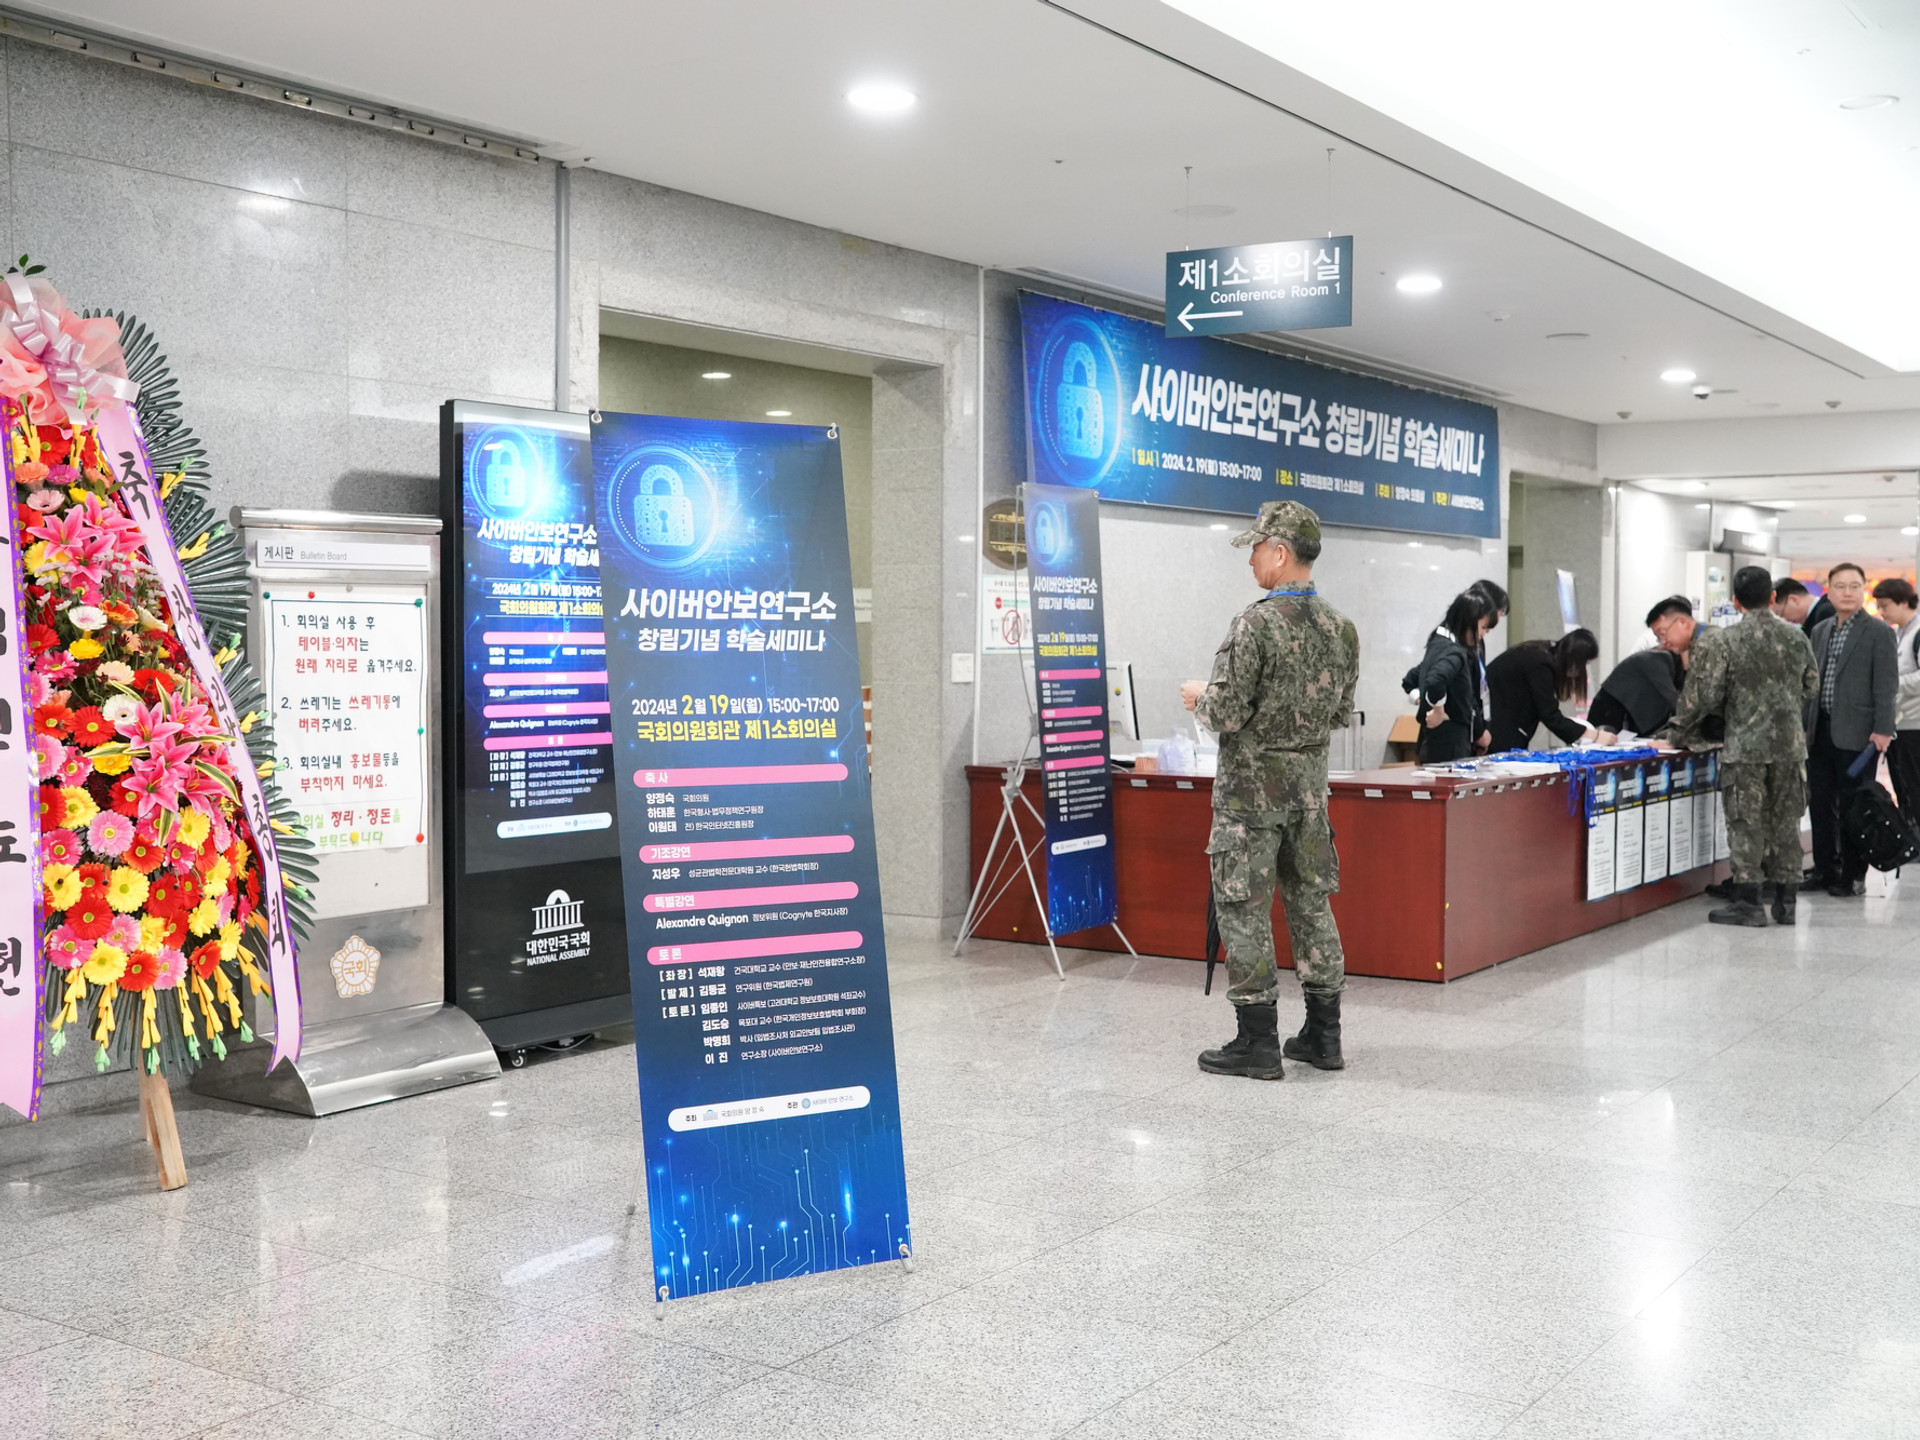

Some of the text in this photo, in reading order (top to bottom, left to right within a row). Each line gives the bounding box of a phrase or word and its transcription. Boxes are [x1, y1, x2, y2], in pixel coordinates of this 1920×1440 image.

[1178, 246, 1341, 291] 제1소회의실
[1210, 281, 1341, 305] Conference Room 1
[1130, 362, 1486, 478] 사이버안보연구소 창립기념 학술세미나
[476, 517, 598, 546] 사이버안보연구소
[264, 546, 347, 561] 게시판 Bulletin Board
[509, 544, 562, 567] 창립기념
[620, 588, 837, 621] 사이버안보연구소
[281, 614, 376, 631] 1. 회의실 사용 후
[638, 627, 826, 652] 창립기념 학술세미나
[295, 658, 318, 674] 원래
[325, 658, 358, 673] 자리로
[281, 694, 401, 711] 2. 쓰레기는 쓰레기통에
[632, 693, 840, 715] 2024년 2월 19일(월) 15:00~17:00
[298, 717, 357, 733] 버려주세요.
[637, 718, 837, 743] 국회의원회관 제1소회의실
[300, 755, 342, 770] 회의실내
[300, 773, 388, 793] 부착하지 마세요.
[645, 792, 710, 805] 양정숙 국회의원
[647, 806, 676, 818] 하태훈
[648, 820, 677, 833] 이원태
[650, 846, 692, 860] 기조강연
[652, 867, 681, 881] 지성우
[755, 864, 769, 875] 교수
[654, 894, 695, 909] 특별강연
[655, 915, 707, 931] Alexandre
[707, 913, 749, 929] Quignon
[526, 946, 591, 967] NATIONAL ASSEMBLY
[343, 958, 369, 978] 국회
[768, 962, 782, 973] 교수
[759, 1015, 773, 1026] 교수
